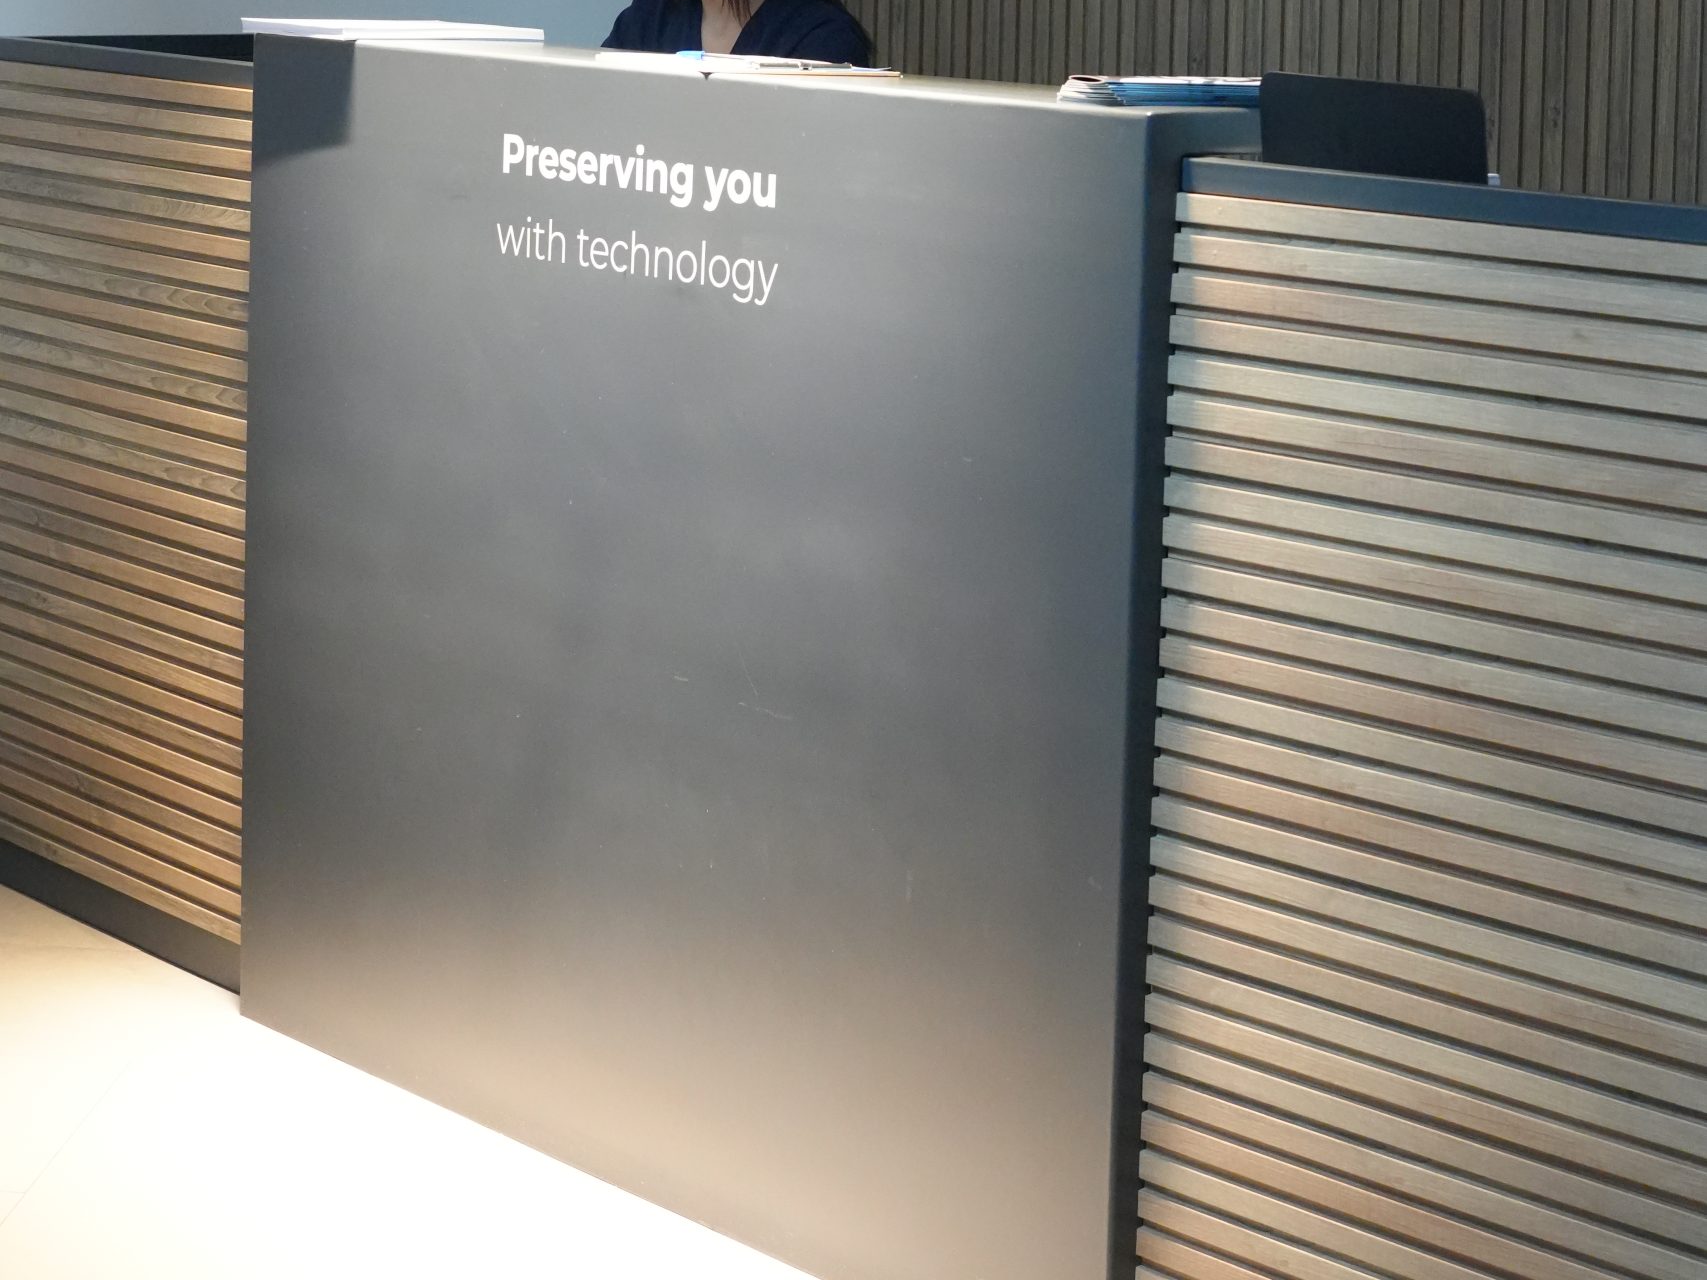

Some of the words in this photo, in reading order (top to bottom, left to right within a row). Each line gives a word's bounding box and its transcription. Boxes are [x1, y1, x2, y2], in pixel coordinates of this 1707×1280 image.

[502, 133, 694, 208] Preserving
[702, 165, 777, 211] you
[496, 215, 566, 263] with
[577, 229, 779, 305] technology
